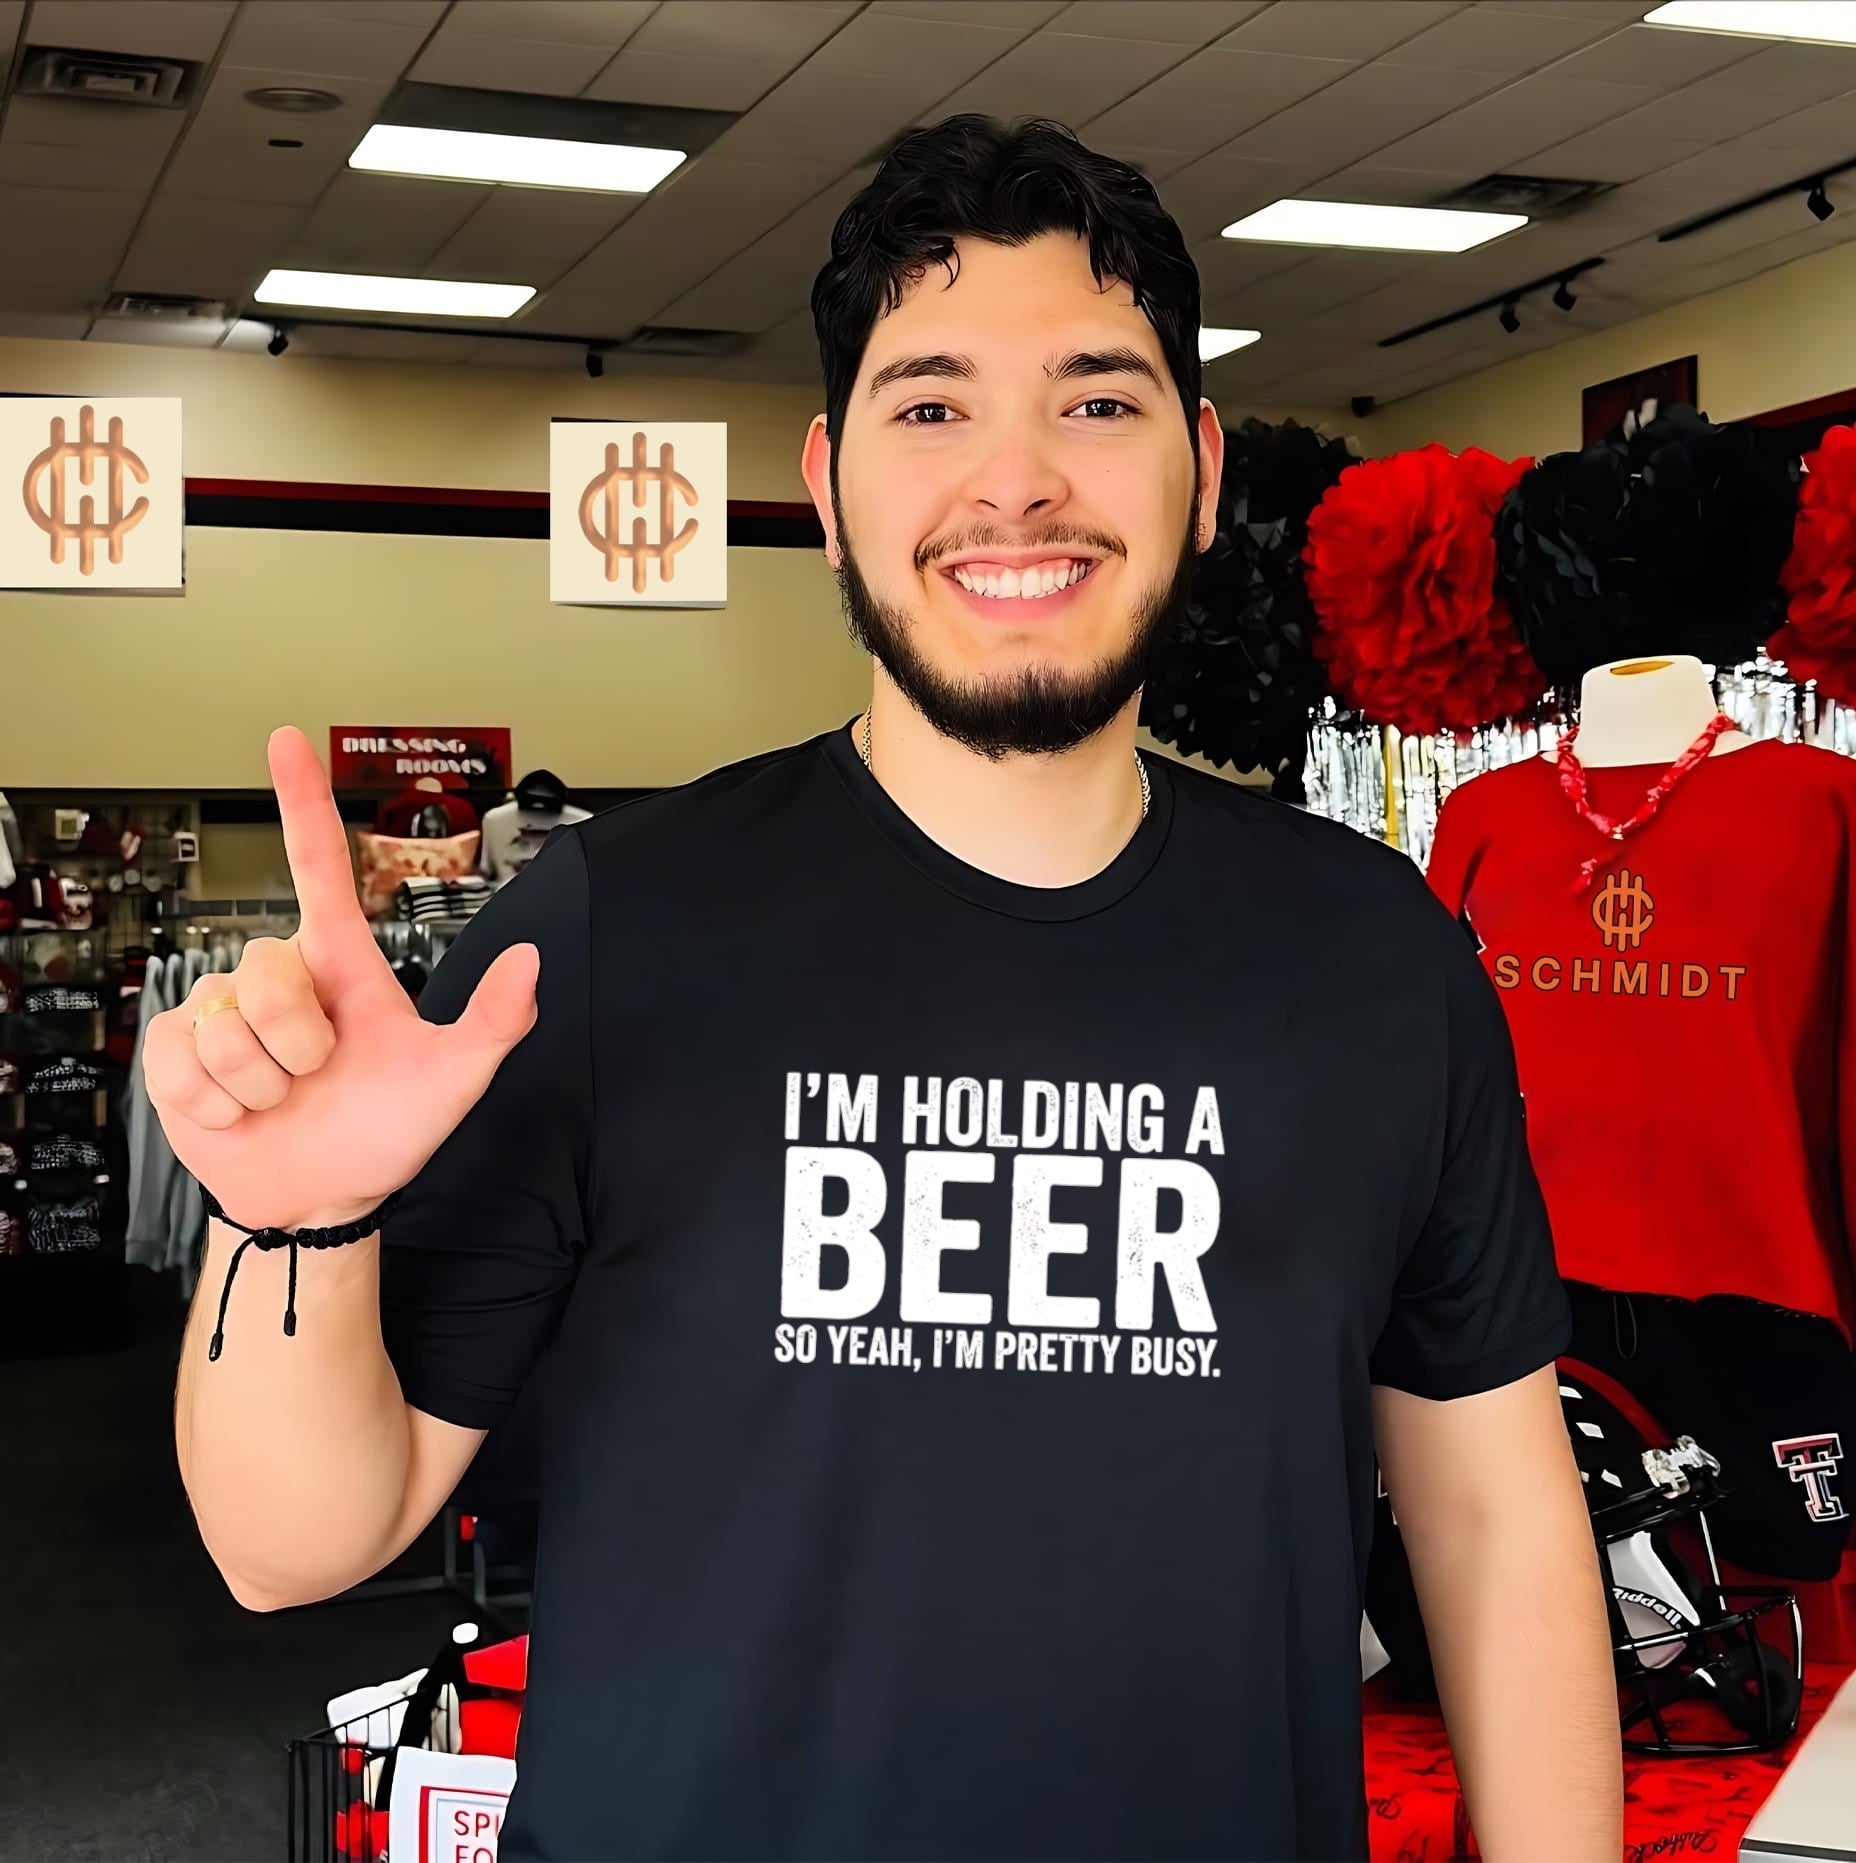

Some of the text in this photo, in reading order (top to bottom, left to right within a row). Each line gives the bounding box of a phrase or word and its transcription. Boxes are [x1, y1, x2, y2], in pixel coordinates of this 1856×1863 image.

[342, 737, 467, 754] DRESSING
[396, 758, 487, 774] ROOMS
[1494, 954, 1747, 1000] SCHMIDT
[784, 1071, 1226, 1156] I'M HOLDING A
[780, 1145, 1221, 1333] BEER
[773, 1322, 1221, 1378] SO YEAH, I'M PRETTY BUSY.
